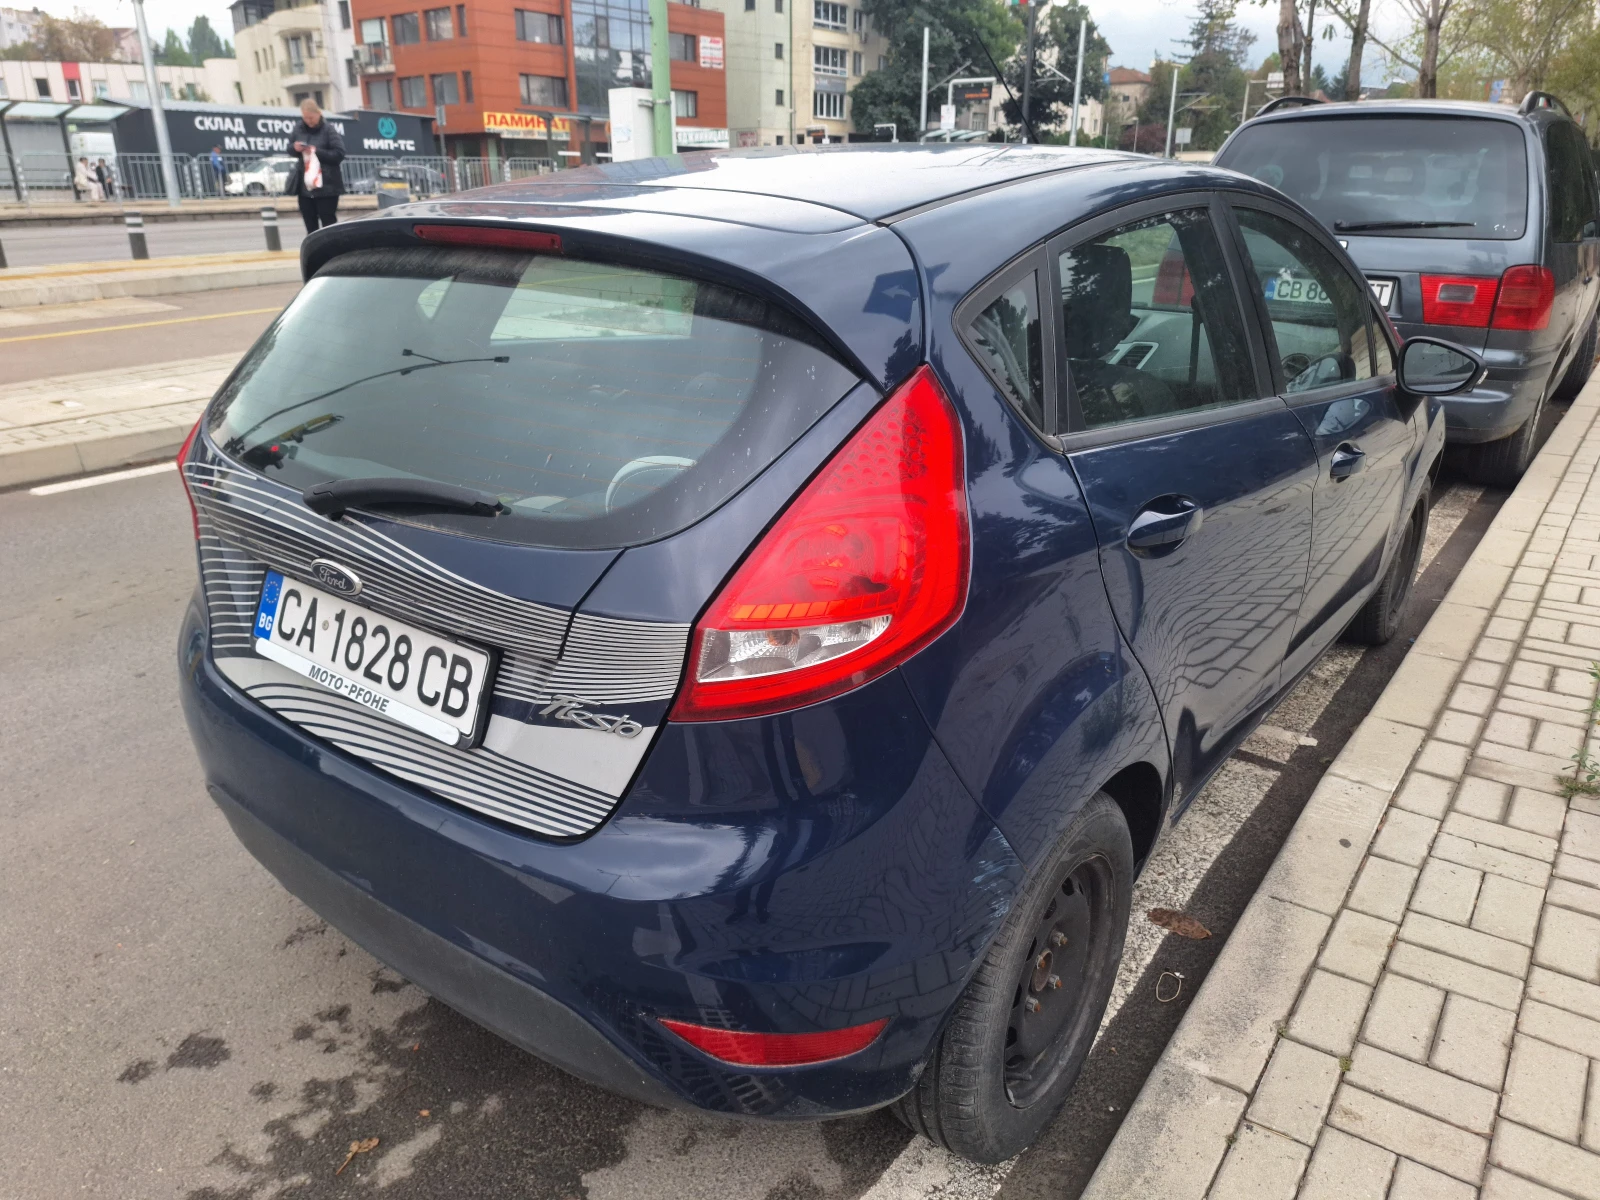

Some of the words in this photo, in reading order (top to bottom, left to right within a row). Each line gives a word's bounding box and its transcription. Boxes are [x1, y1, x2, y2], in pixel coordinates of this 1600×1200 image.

[194, 115, 246, 134] СКЛАД
[486, 113, 569, 130] ЛАМИНАТ
[363, 138, 416, 151] МИП-ТС
[1277, 280, 1302, 299] CB
[317, 566, 348, 592] Ford
[258, 611, 274, 632] BG
[277, 587, 319, 654] CA
[329, 607, 413, 692] 1828
[417, 645, 474, 719] CB
[537, 693, 643, 740] Fiesta
